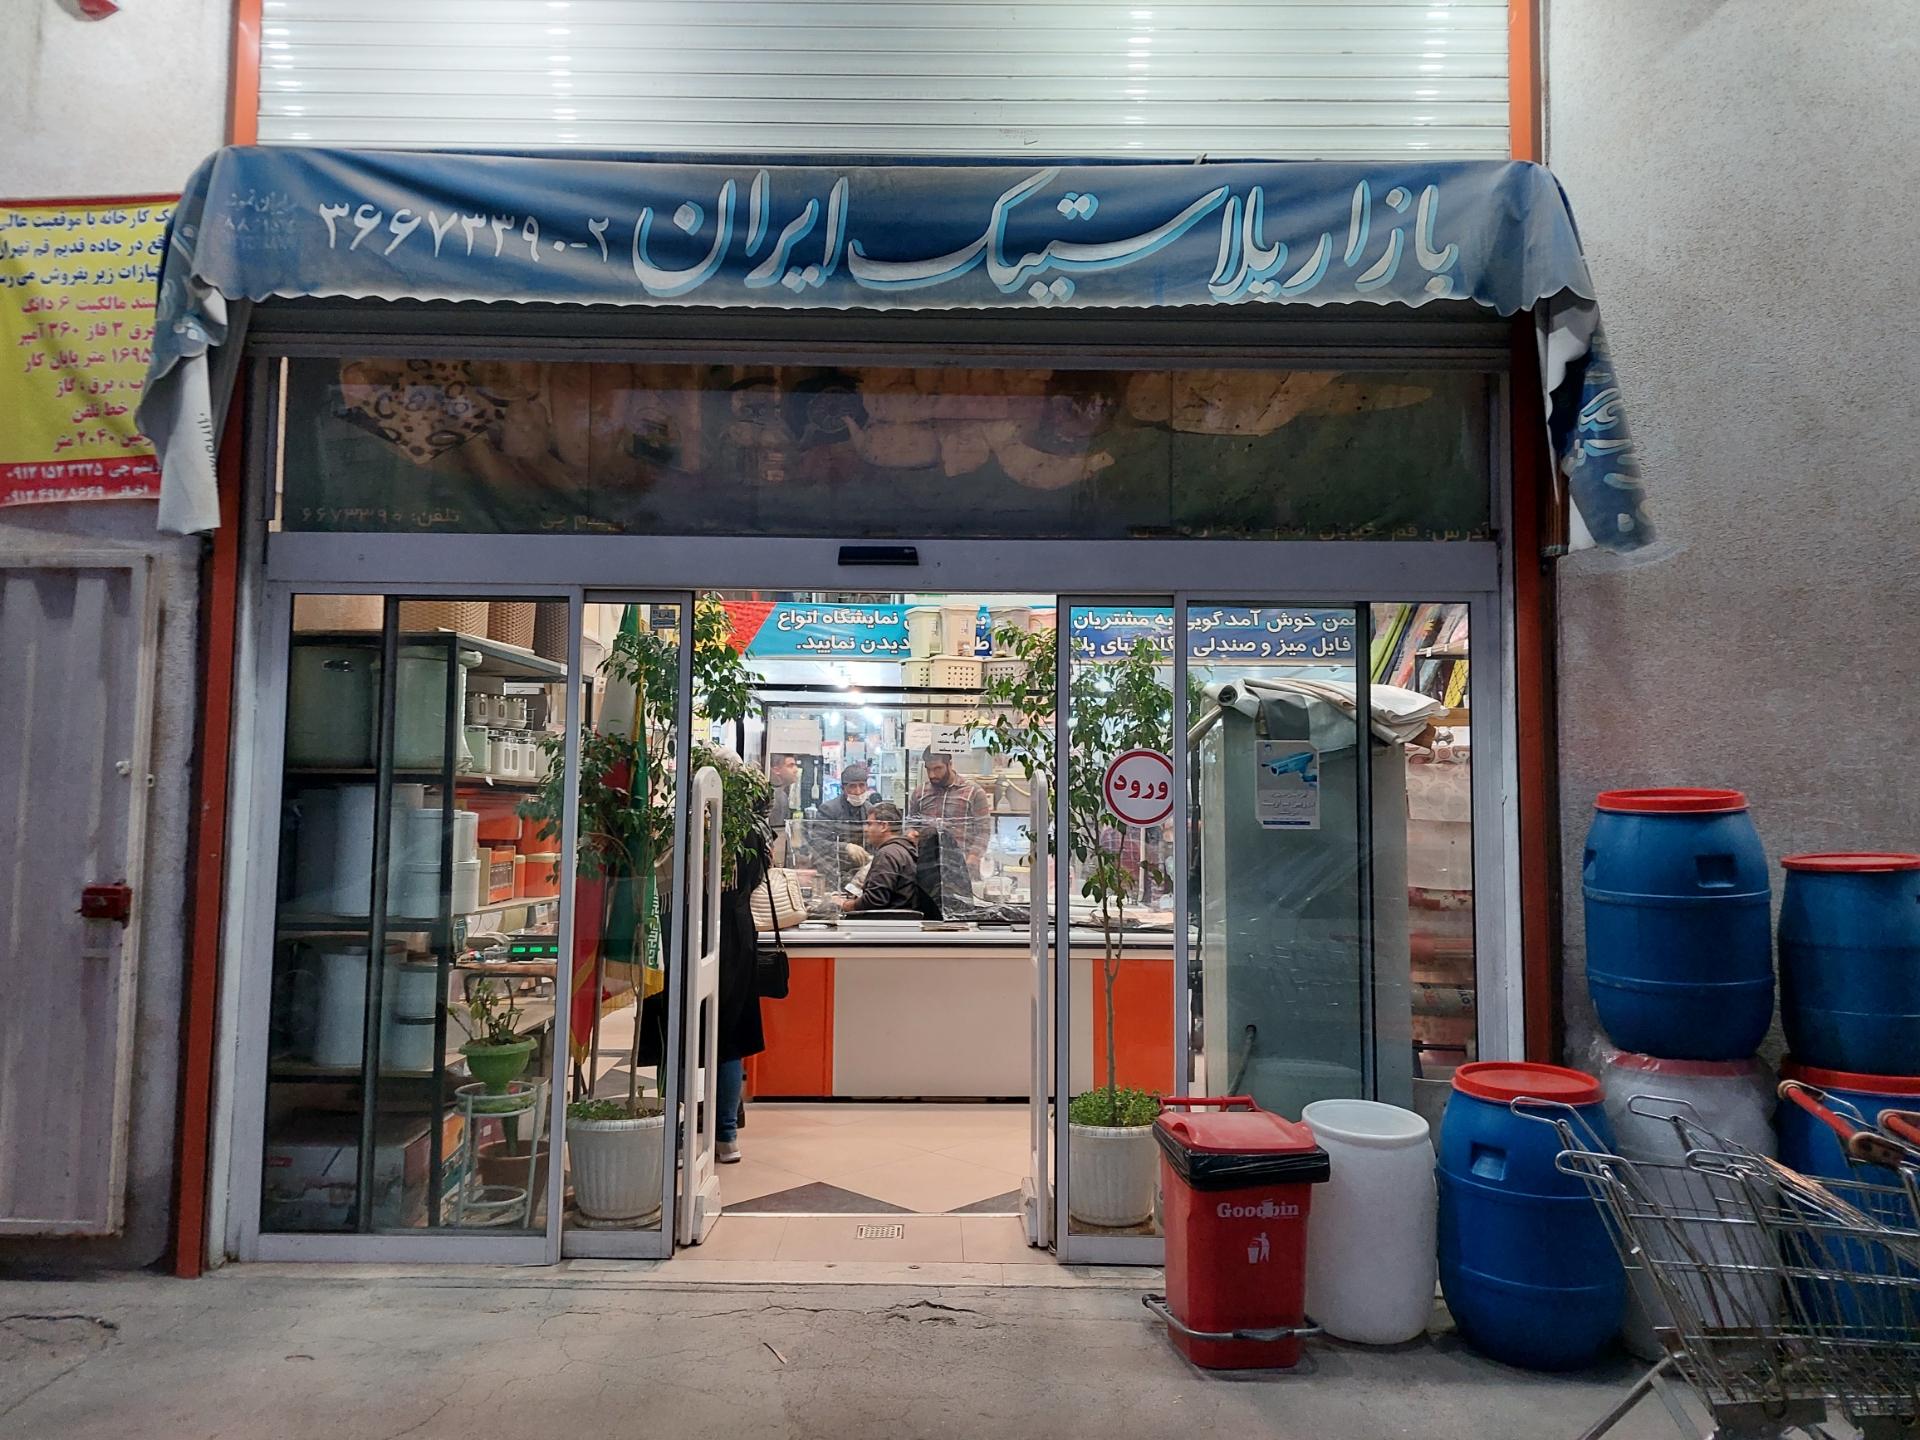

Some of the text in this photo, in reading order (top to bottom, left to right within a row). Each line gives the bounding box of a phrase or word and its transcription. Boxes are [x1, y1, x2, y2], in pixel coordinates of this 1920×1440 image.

[32, 211, 82, 231] موقعیت
[86, 211, 96, 230] با
[632, 169, 851, 299] ایران
[847, 168, 1289, 303] پلاستیک
[1280, 179, 1459, 298] بازار
[33, 239, 50, 258] قم
[54, 238, 86, 258] قدیم
[90, 239, 122, 256] جاده
[127, 240, 143, 256] در
[93, 267, 115, 285] زیر
[22, 297, 54, 313] دانگ
[58, 295, 70, 311] ۶
[76, 296, 128, 314] مالکیت
[86, 321, 108, 342] فاز
[24, 352, 46, 373] کار
[83, 350, 107, 368] متر
[88, 378, 114, 394] برق
[72, 401, 129, 424] خط تلفن
[53, 434, 74, 453] متر
[777, 609, 819, 632] انواع
[822, 609, 899, 629] نمایشگاه
[1073, 610, 1150, 631] مشتریان
[1266, 612, 1317, 633] خوش
[1321, 613, 1356, 633] من
[796, 635, 855, 654] نمایید.
[1193, 636, 1256, 658] صندلی
[1260, 641, 1272, 657] و
[1275, 640, 1308, 657] میز
[1311, 636, 1353, 658] فایل
[1113, 774, 1169, 800] ورود
